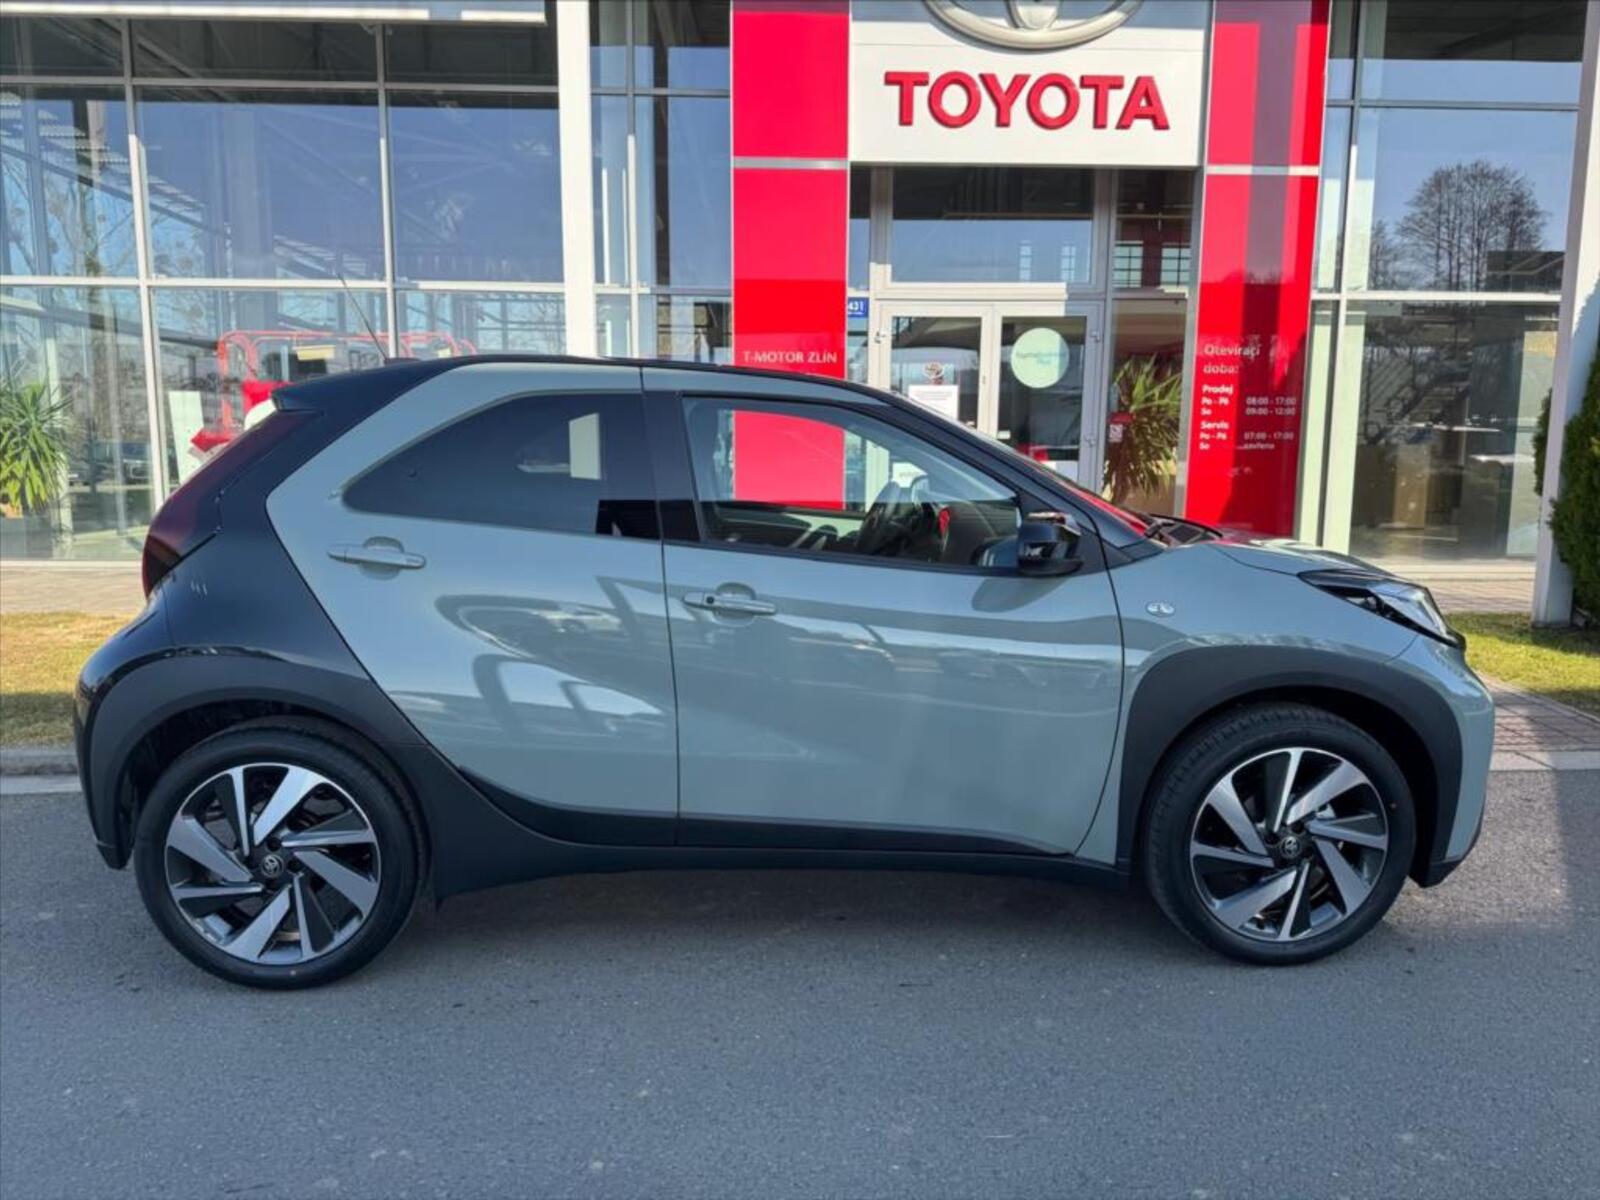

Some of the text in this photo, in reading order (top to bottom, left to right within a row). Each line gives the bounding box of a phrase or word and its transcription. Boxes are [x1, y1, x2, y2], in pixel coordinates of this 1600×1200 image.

[884, 71, 1170, 130] TOYOTA
[743, 349, 838, 363] T-MOTOR ZLÍN
[1203, 362, 1239, 374] doba:
[1202, 384, 1234, 395] Prodej
[1201, 396, 1213, 405] Po
[1201, 407, 1212, 416] So
[1201, 420, 1229, 430] Servis
[1200, 432, 1210, 440] Po
[1199, 442, 1210, 450] So
